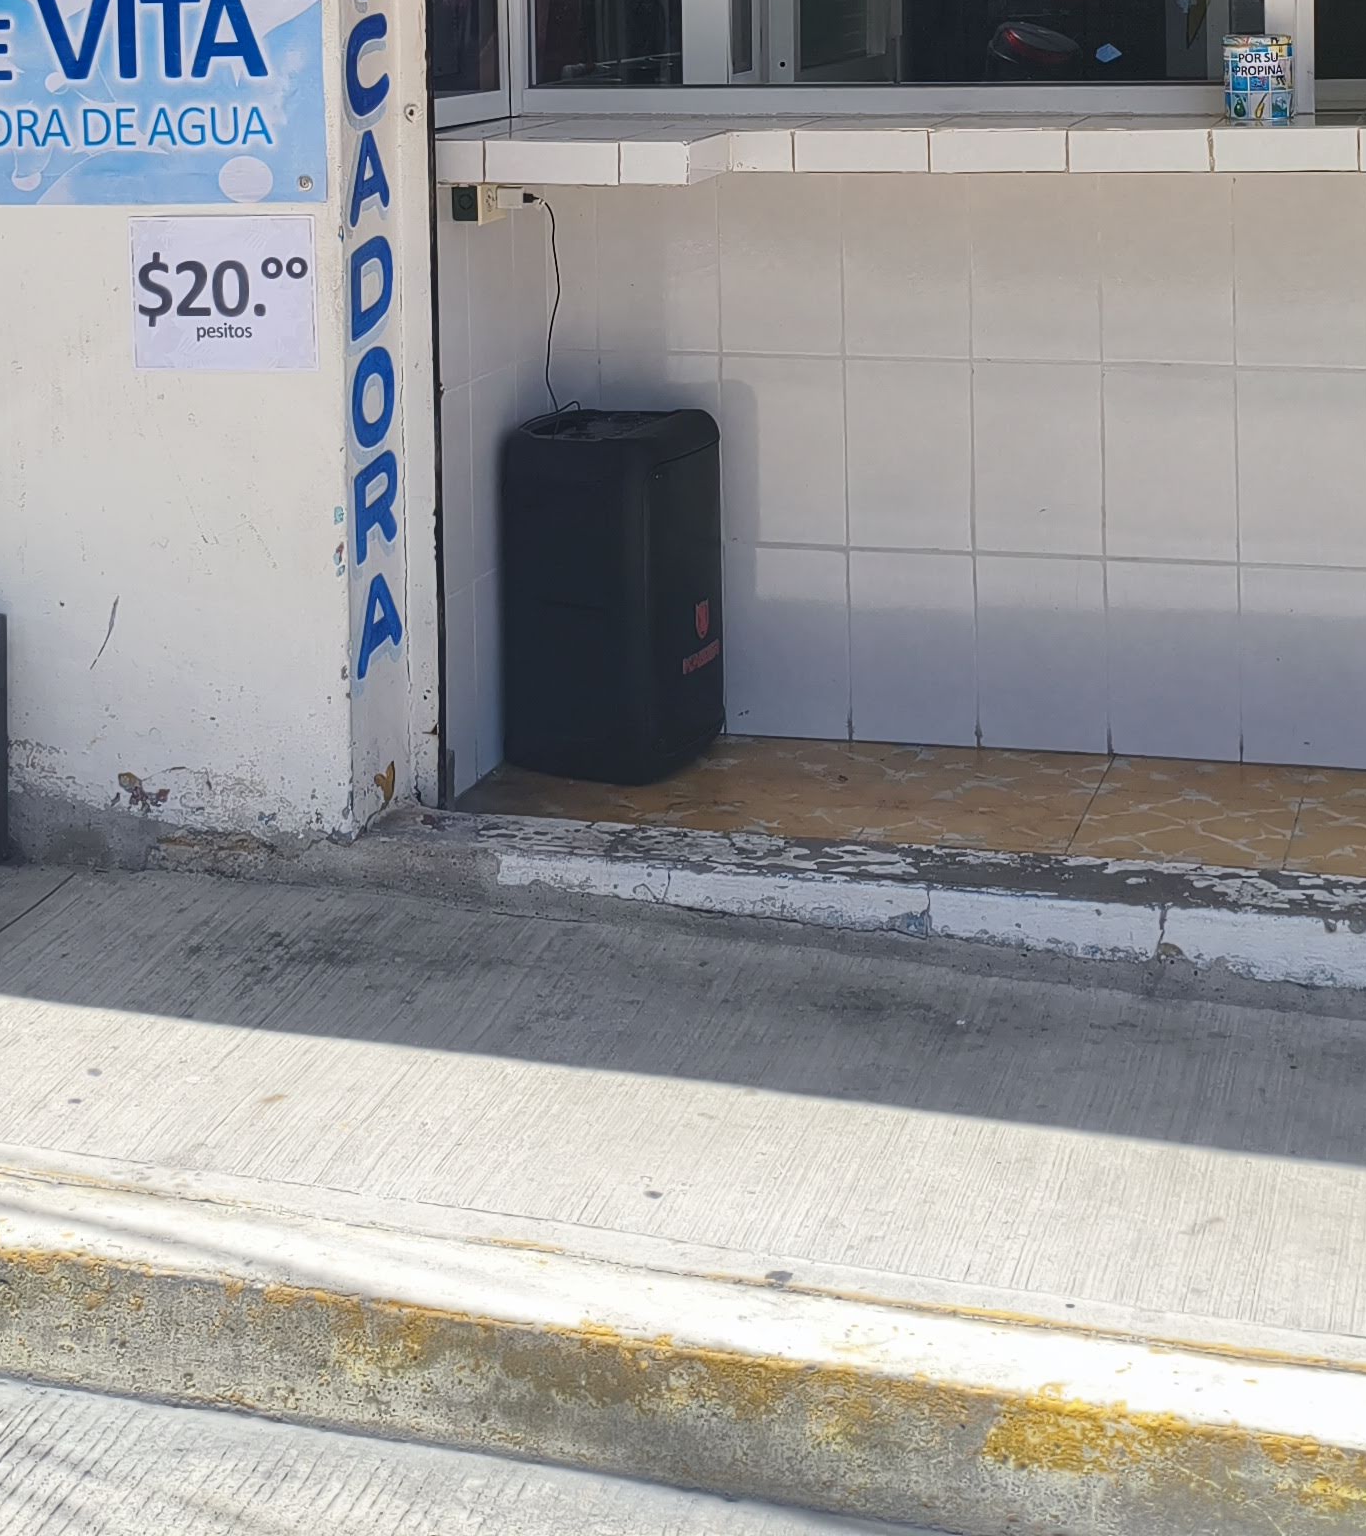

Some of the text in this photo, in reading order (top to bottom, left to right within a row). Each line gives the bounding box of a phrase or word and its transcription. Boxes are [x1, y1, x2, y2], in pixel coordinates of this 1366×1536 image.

[1238, 52, 1278, 63] POR SU
[1235, 65, 1283, 76] PROPINA
[83, 108, 136, 147] DE
[148, 106, 273, 146] AGUA
[195, 322, 254, 342] pesitos
